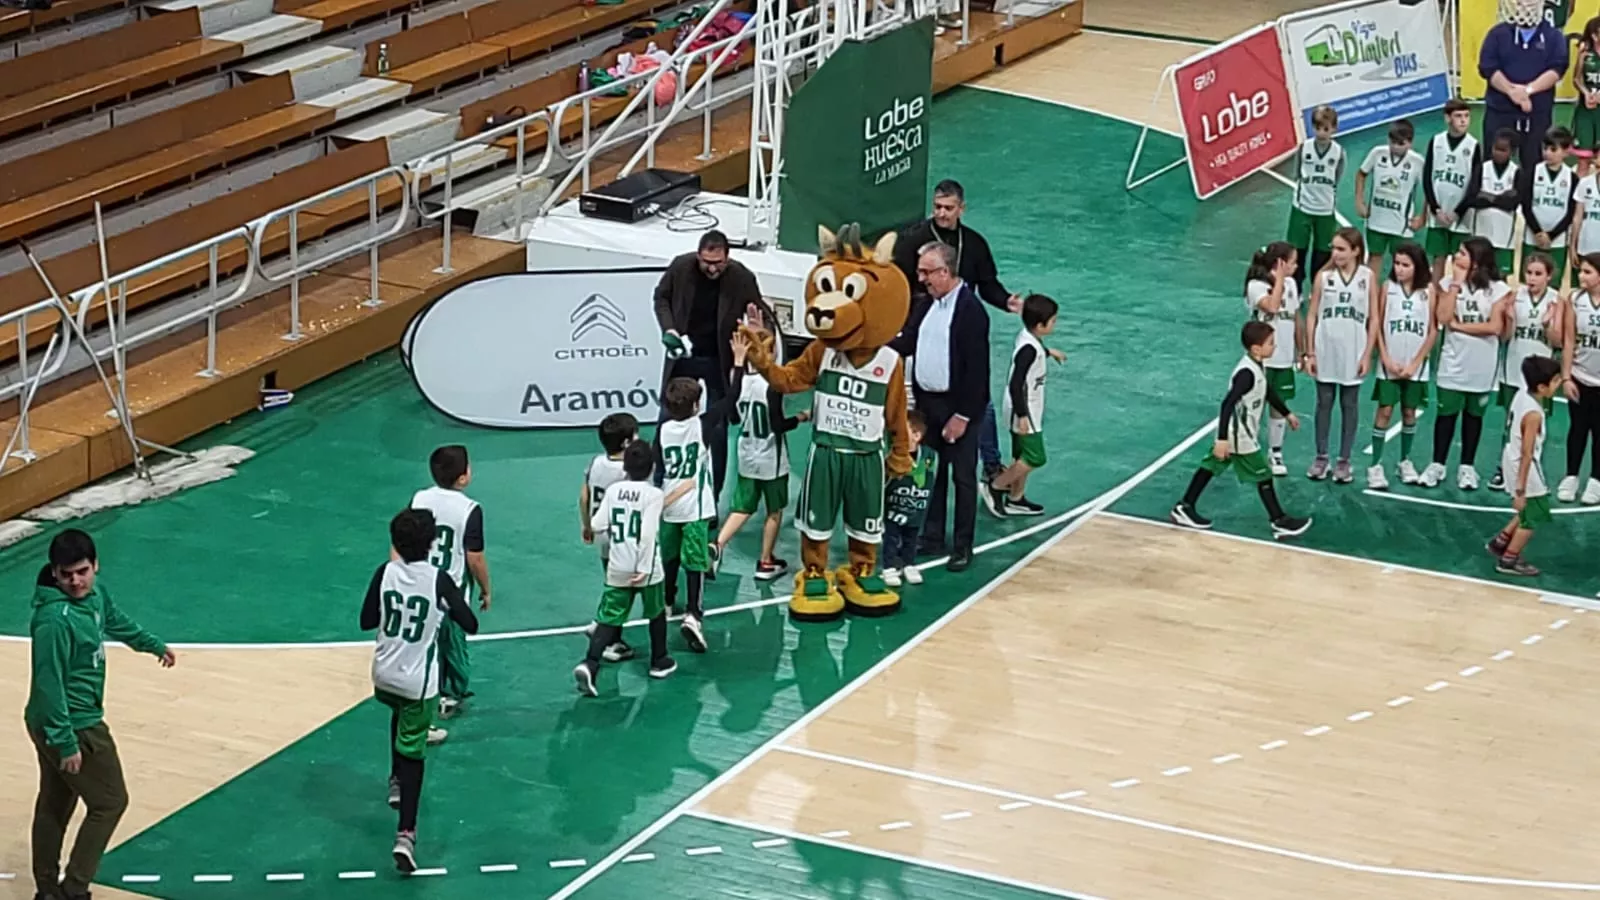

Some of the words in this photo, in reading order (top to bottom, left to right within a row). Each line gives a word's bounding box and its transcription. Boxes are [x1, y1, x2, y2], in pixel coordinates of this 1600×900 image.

[865, 96, 924, 140] Lobe
[1202, 90, 1269, 143] Lobe
[1390, 315, 1425, 337] PEÑAS
[838, 376, 868, 399] 00
[617, 488, 641, 502] IAN
[611, 507, 642, 545] 54
[382, 589, 430, 643] 63
